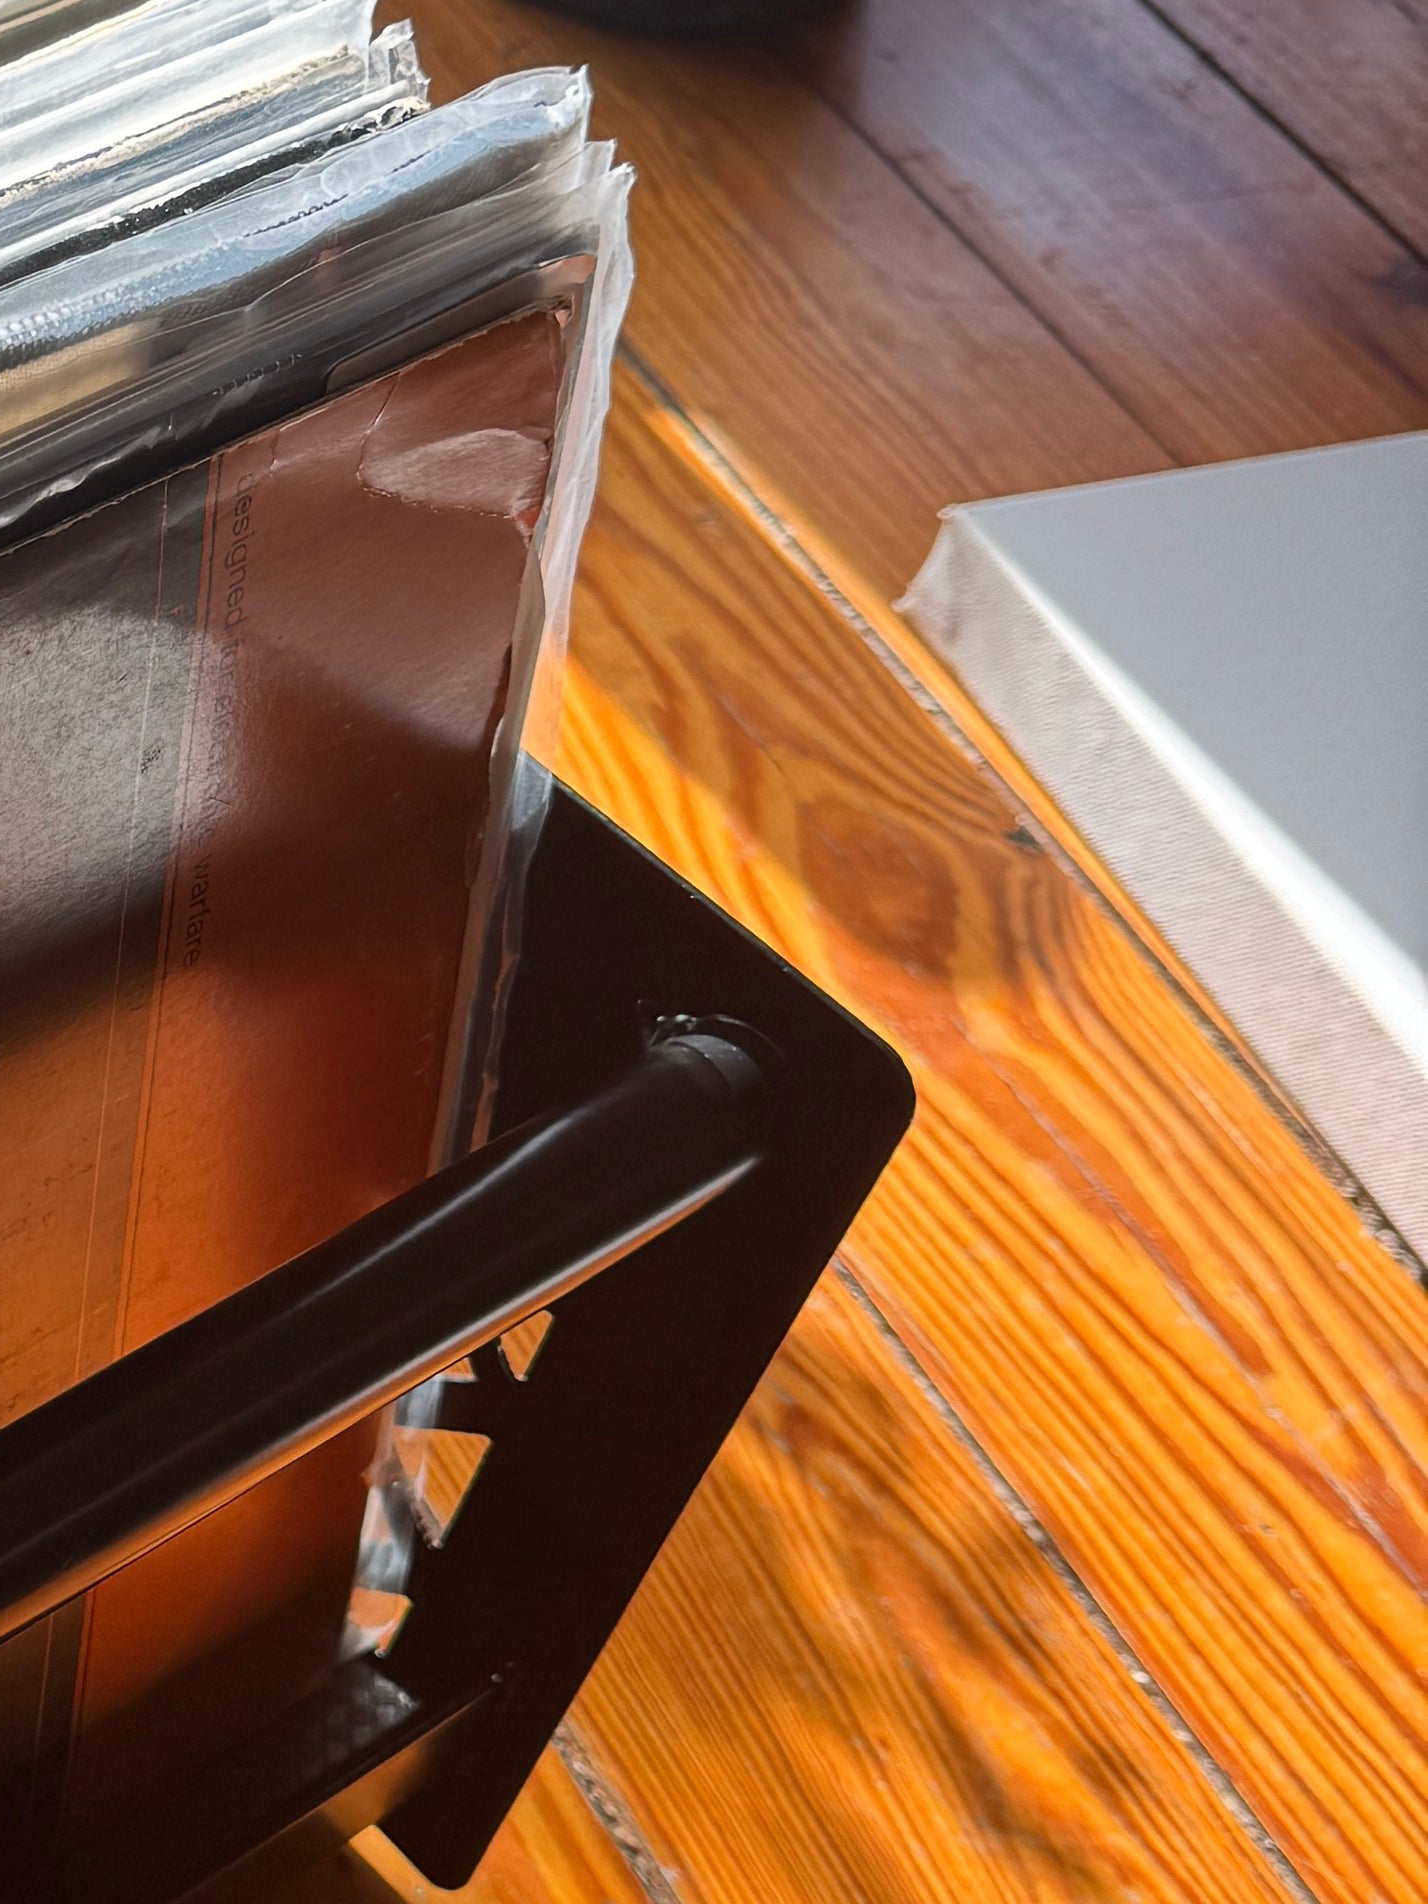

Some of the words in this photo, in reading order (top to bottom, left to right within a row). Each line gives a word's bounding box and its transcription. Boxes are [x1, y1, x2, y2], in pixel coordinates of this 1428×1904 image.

[224, 472, 259, 631] designed
[217, 638, 240, 681] for
[183, 853, 213, 969] warfare
